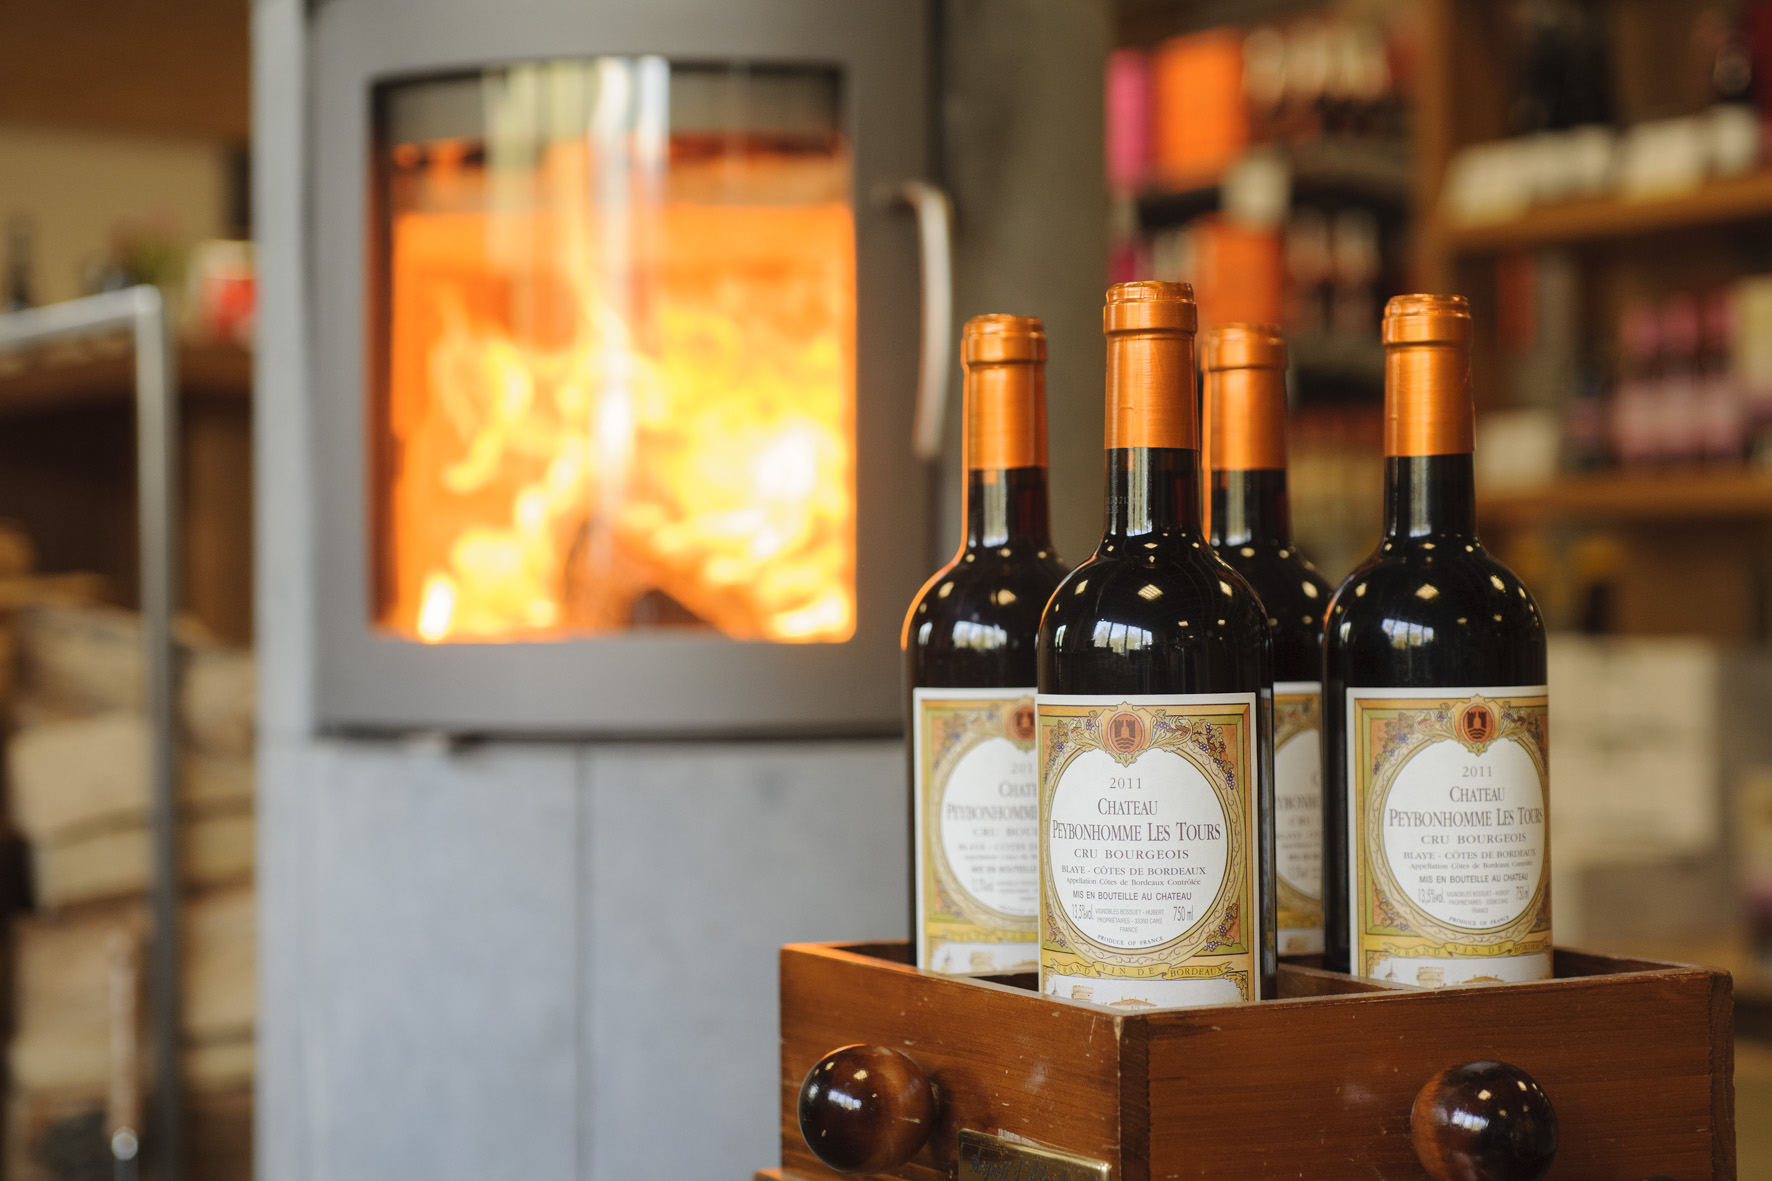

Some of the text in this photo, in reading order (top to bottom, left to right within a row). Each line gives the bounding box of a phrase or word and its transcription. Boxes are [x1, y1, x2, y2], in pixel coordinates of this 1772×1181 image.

[1010, 762, 1036, 775] 201
[1462, 766, 1492, 777] 2011
[1109, 778, 1142, 789] 2011
[1450, 786, 1505, 802] CHATEAU
[1097, 798, 1158, 815] CHATEAU
[1389, 807, 1542, 828] PEYBONHOMME LES TOURS
[1052, 820, 1142, 841] PEYBONHOMME
[1148, 823, 1170, 841] LES
[1176, 822, 1221, 840] TOURS
[1421, 833, 1527, 845] CRU BOURGEOIS
[1074, 849, 1189, 860] CRU BOURGEOIS
[1404, 852, 1435, 860] BLAYE
[1445, 850, 1478, 859] CÔTES
[1497, 848, 1536, 859] BORDEAUX
[1061, 865, 1085, 874] BLAYE
[1093, 866, 1125, 876] CÔTES
[1129, 867, 1144, 876] DE
[1148, 867, 1206, 875] BORDEAUX
[1450, 875, 1489, 883] BOUTEILLE
[1491, 875, 1500, 883] AU
[1503, 873, 1528, 882] CHATEAU
[1072, 891, 1192, 900] MIS EN BOUTEILLE AU CHATEAU
[1174, 905, 1193, 921] 750 ml
[1449, 917, 1476, 925] PRODUCE
[1098, 935, 1124, 945] PRODUCE
[1140, 936, 1164, 945] FRANCE
[1454, 946, 1479, 954] VIN
[1489, 945, 1502, 954] DE
[1056, 964, 1223, 977] GRAND VIN DE BORDEAUX
